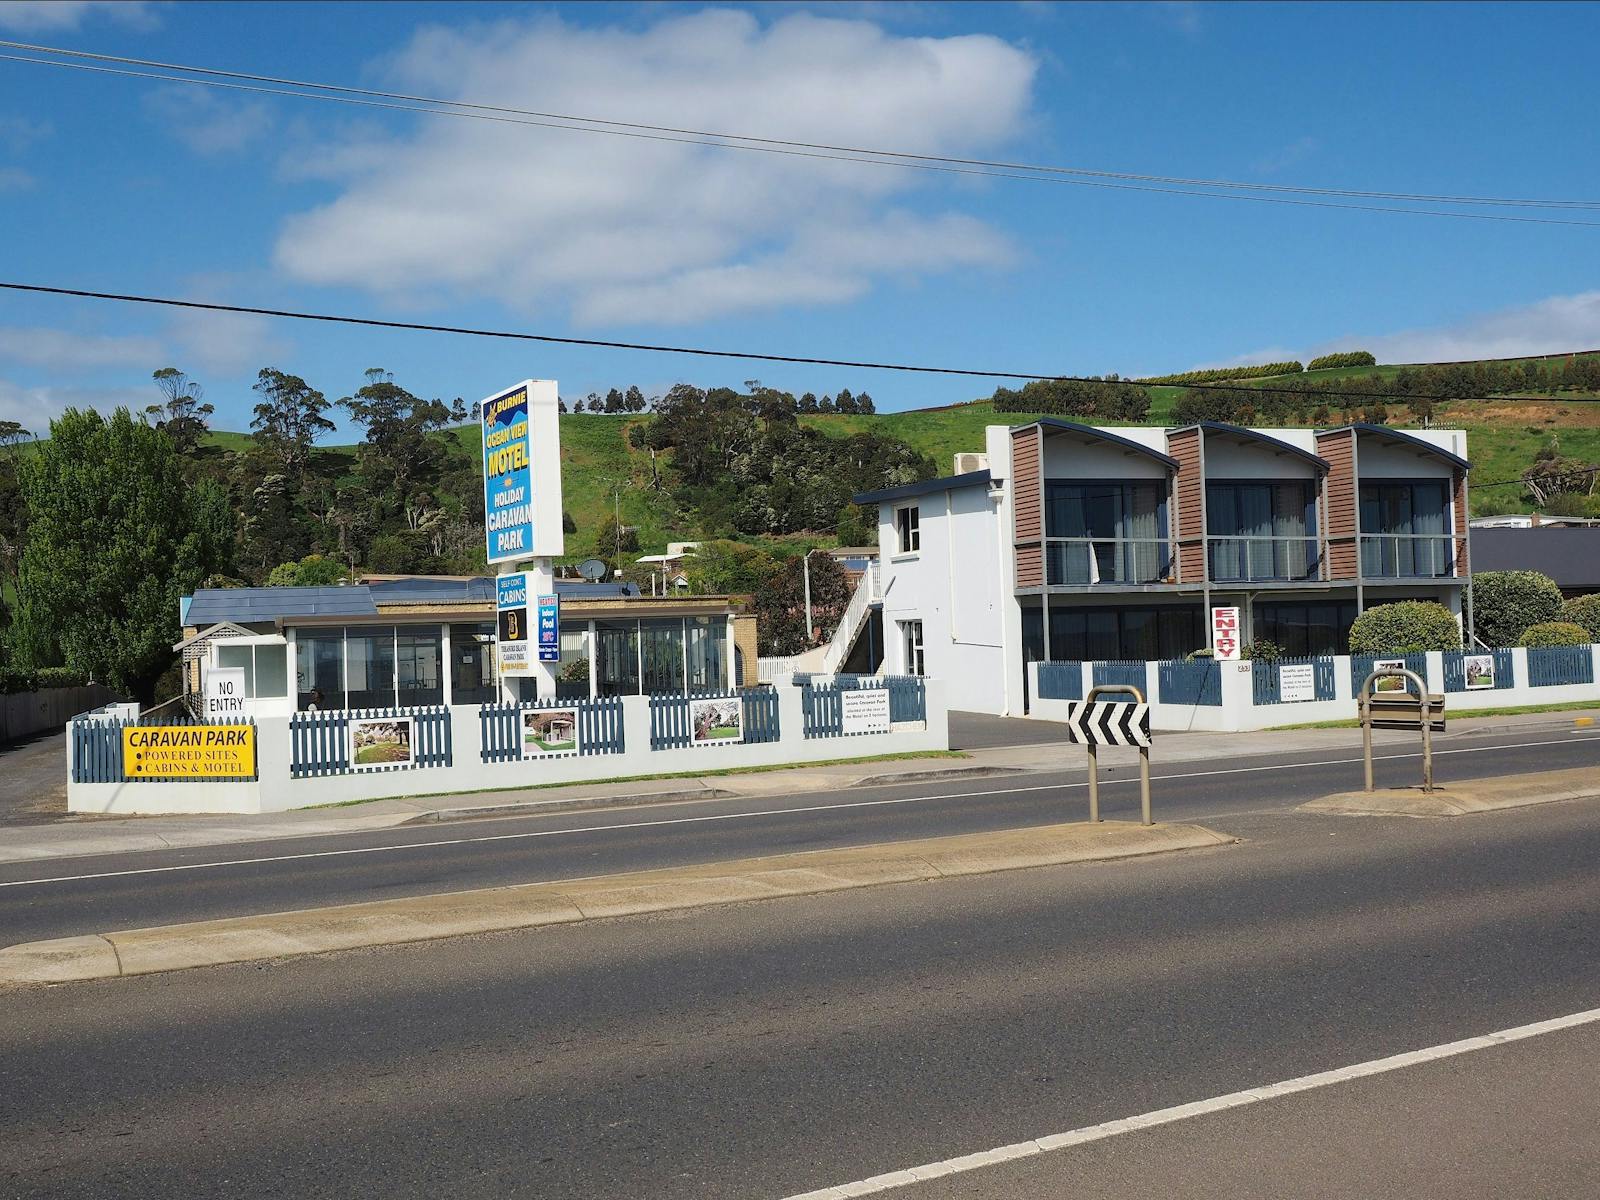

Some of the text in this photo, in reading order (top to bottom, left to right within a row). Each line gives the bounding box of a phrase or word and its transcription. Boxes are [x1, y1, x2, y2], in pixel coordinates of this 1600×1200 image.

[497, 390, 527, 413] BURNIE
[487, 421, 528, 448] OCEAN VIEW
[488, 441, 529, 478] MOTEL
[494, 486, 525, 508] HOLIDAY
[488, 504, 533, 531] CARAVAN
[498, 529, 524, 551] PARK
[499, 588, 526, 604] CABINS
[542, 618, 555, 629] Pool
[1215, 609, 1236, 657] ENTRY
[219, 681, 234, 695] NO
[210, 697, 244, 712] ENTRY
[129, 730, 248, 747] CARAVAN PARK
[145, 750, 238, 761] POWERED SITES
[145, 763, 246, 773] CABINS & MOTEL
